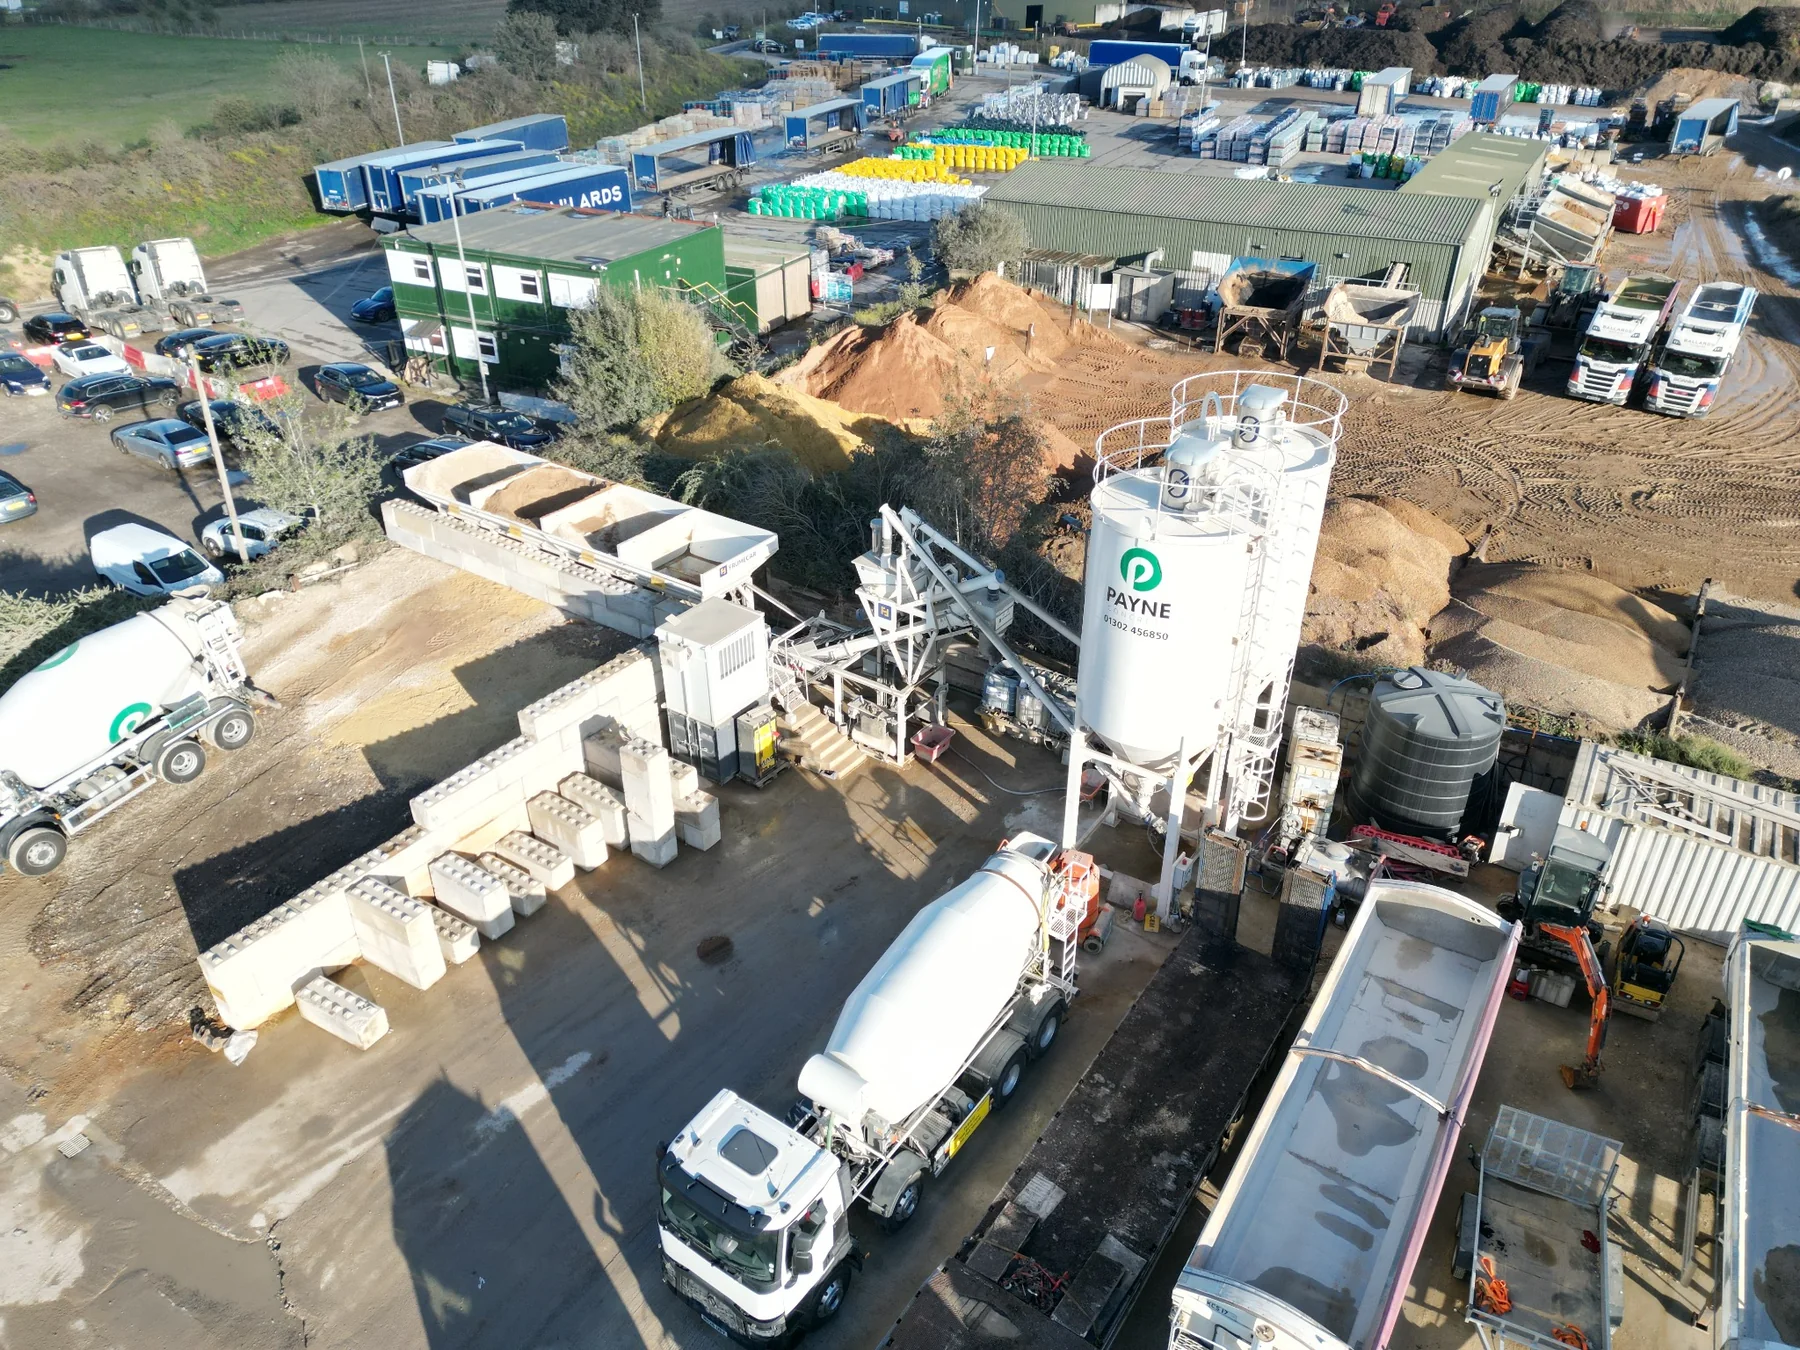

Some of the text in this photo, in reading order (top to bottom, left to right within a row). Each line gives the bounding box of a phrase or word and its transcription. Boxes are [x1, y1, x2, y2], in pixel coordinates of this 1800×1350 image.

[1106, 586, 1172, 619] PAYNE
[1103, 614, 1169, 641] 01302 456850
